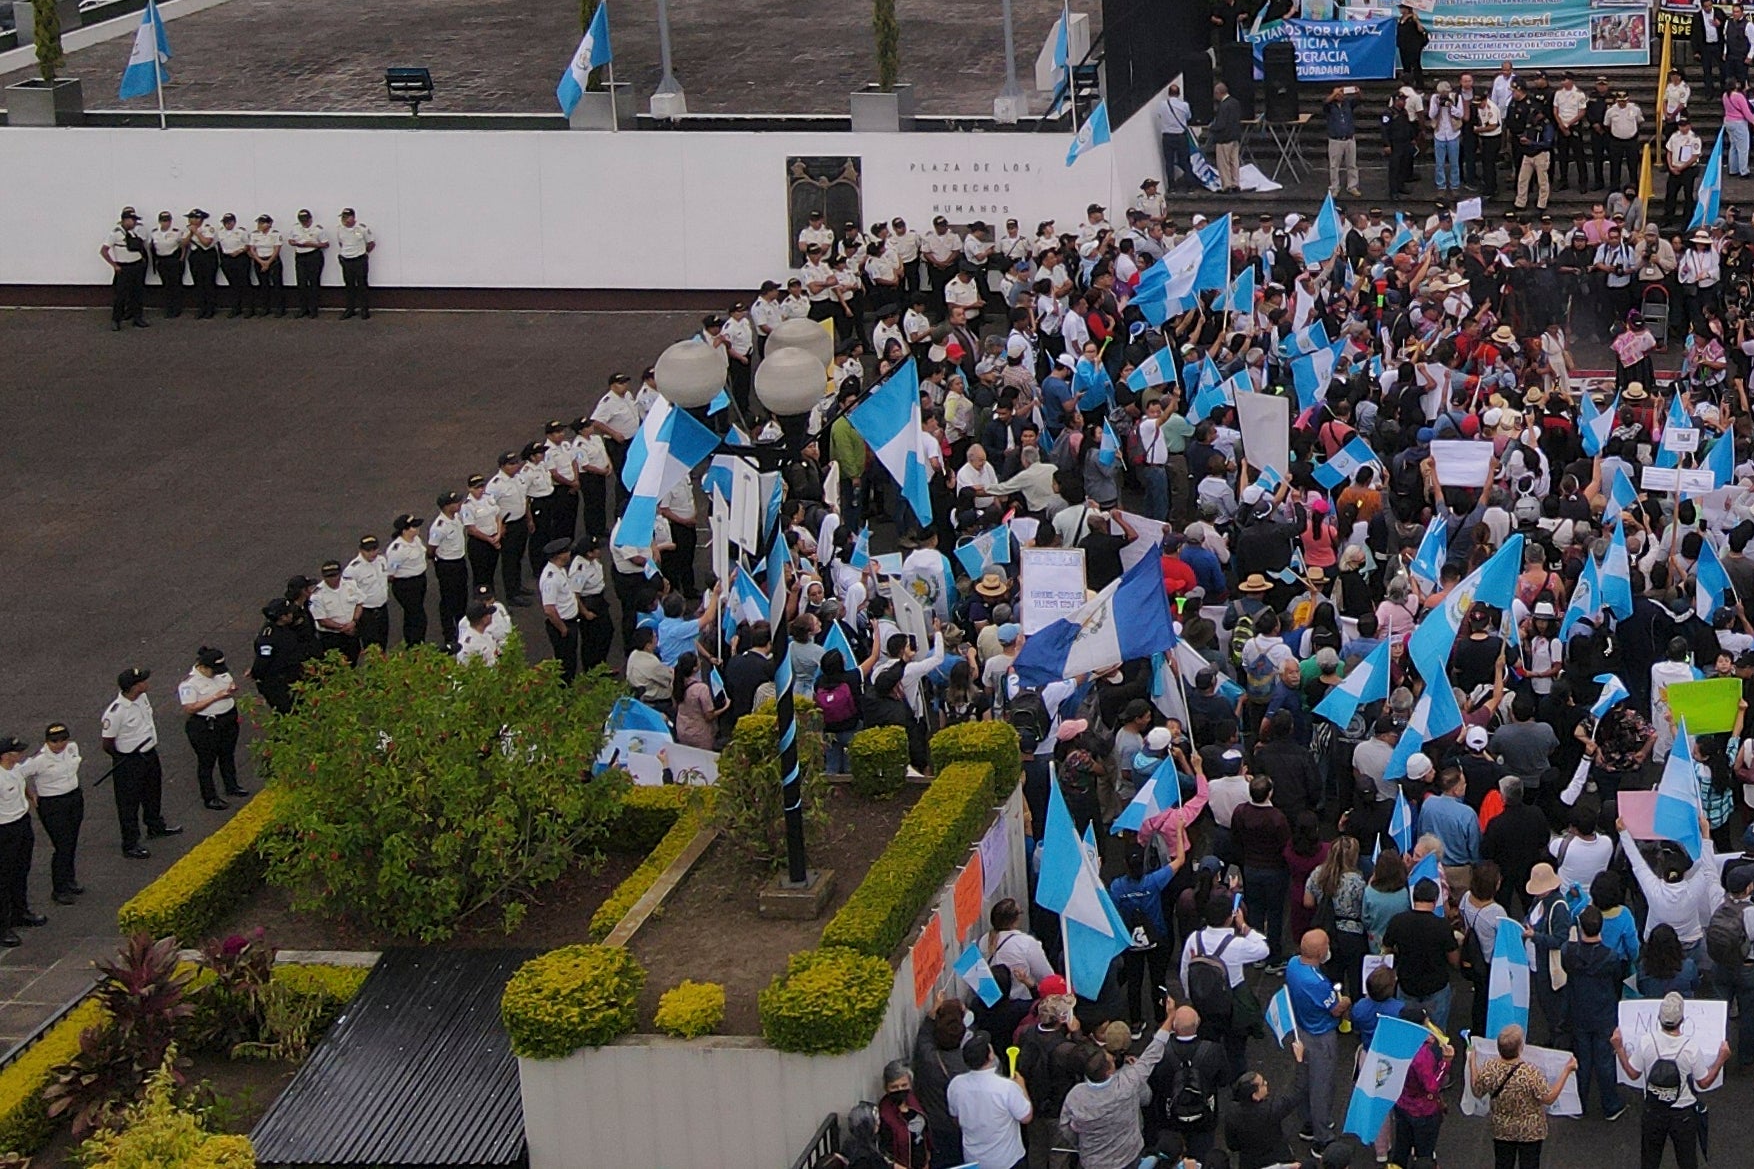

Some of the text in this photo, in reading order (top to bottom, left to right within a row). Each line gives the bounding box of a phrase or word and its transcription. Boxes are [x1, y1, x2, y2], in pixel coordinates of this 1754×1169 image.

[1305, 25, 1330, 37] POR
[1335, 26, 1351, 37] LA
[1456, 32, 1498, 40] DEFENSA
[1527, 30, 1589, 38] DEMOCRACIA
[1332, 38, 1342, 48] Y
[910, 163, 1031, 172] PLAZA DE LOS
[932, 183, 1011, 193] DERECHOS
[932, 204, 1010, 214] HUMANOS
